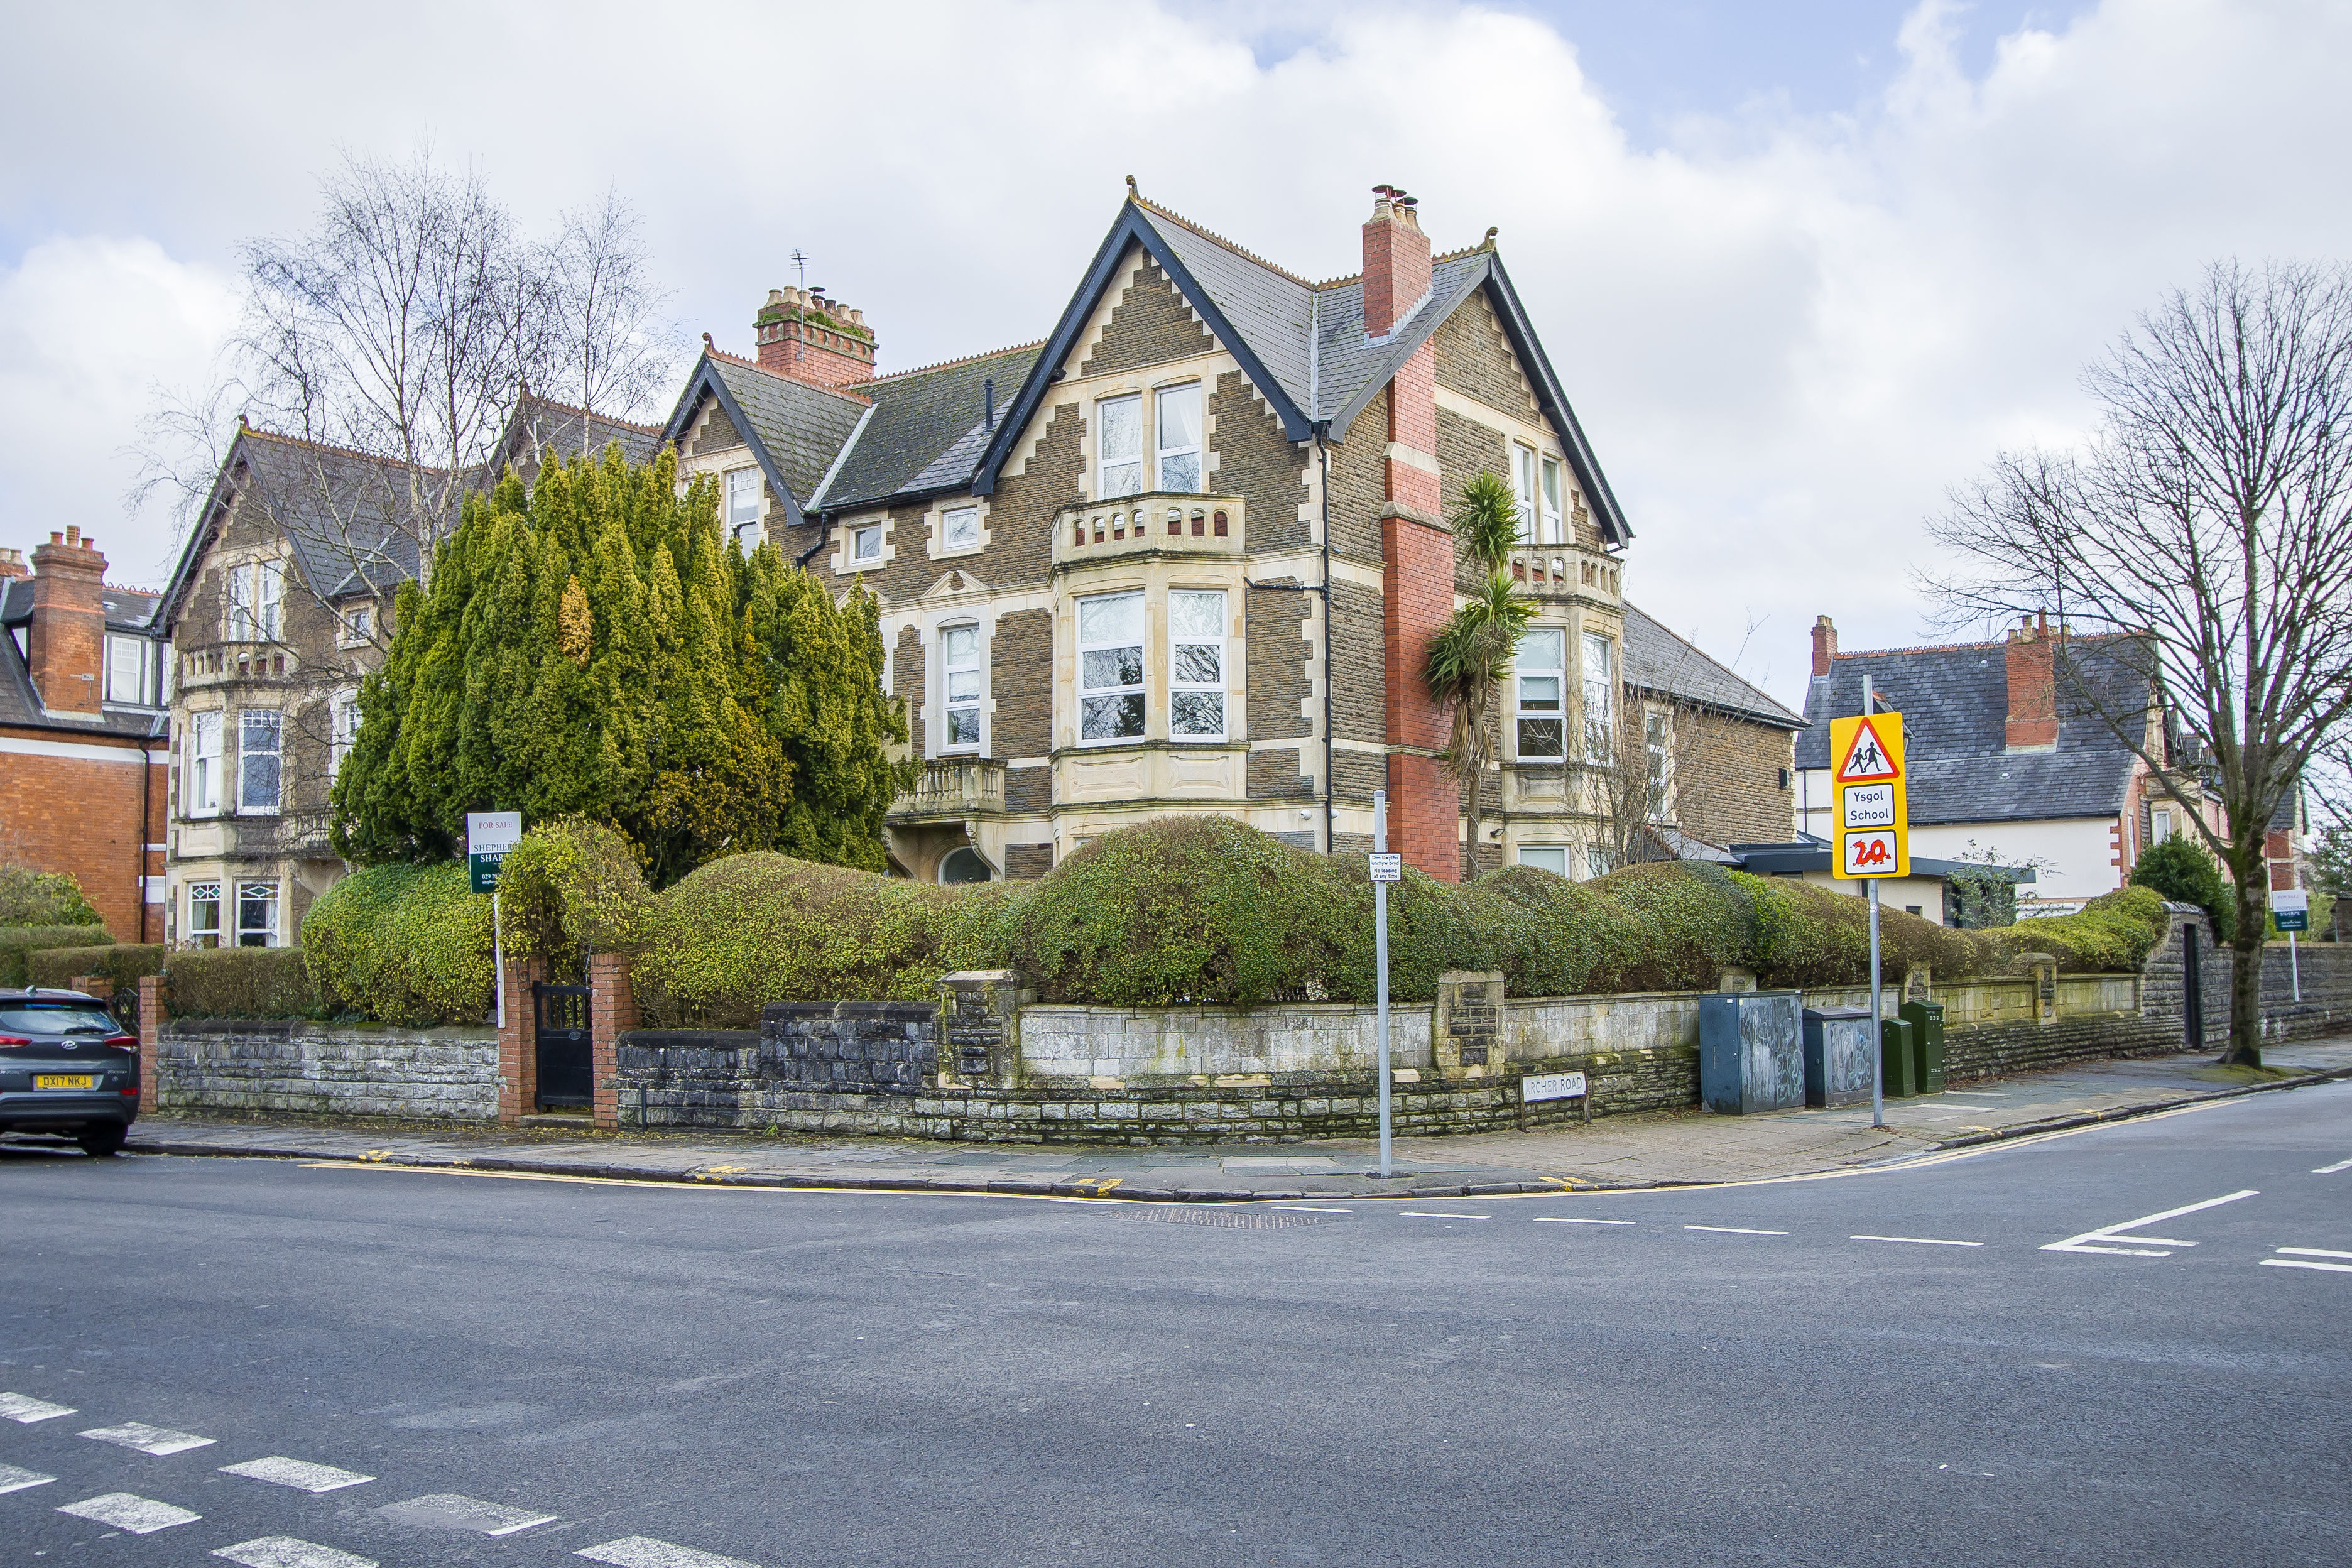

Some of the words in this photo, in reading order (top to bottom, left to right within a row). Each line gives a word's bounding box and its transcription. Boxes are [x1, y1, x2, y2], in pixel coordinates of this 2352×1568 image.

[1854, 790, 1884, 803] Ysgol
[1850, 808, 1889, 821] School
[474, 843, 514, 852] SHEPHER
[480, 854, 504, 863] SHAR
[43, 1076, 65, 1086] DX17
[68, 1076, 87, 1086] NKJ
[1525, 1079, 1557, 1095] ARCHER
[1560, 1077, 1582, 1091] ROAD
